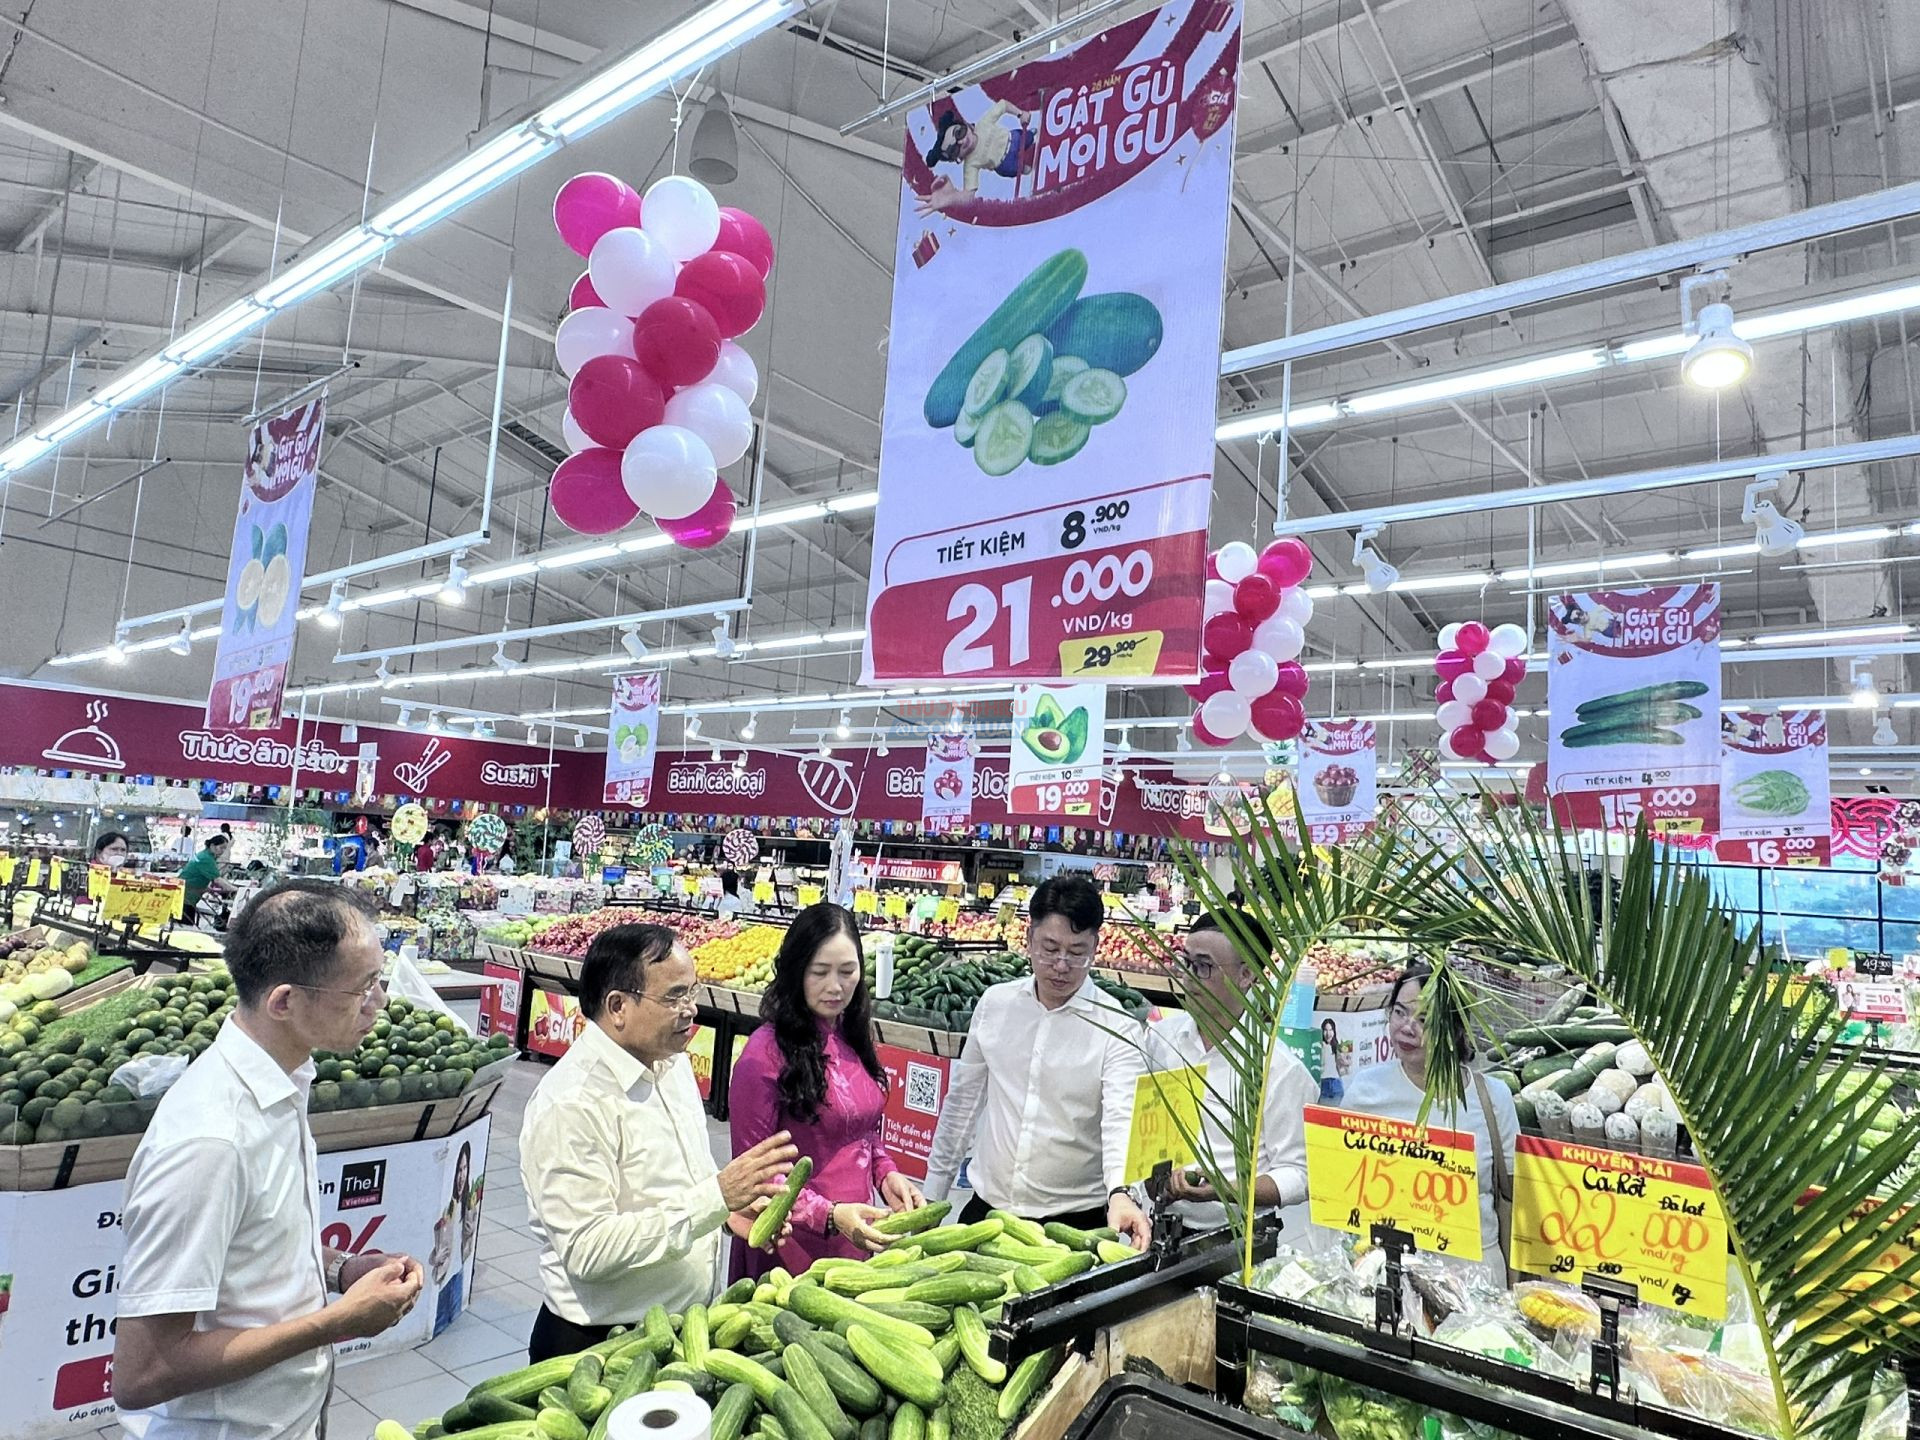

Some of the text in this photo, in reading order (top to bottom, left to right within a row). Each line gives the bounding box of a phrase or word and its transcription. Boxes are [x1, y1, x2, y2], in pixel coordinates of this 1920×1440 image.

[1045, 61, 1176, 137] GẬT GÙ
[1036, 124, 1108, 191] MỌI
[1113, 102, 1178, 164] GU
[1092, 524, 1121, 535] VND/kg
[937, 536, 975, 564] TIẾT
[980, 530, 1025, 556] KIỆM
[942, 574, 1034, 676] 21
[1062, 611, 1133, 635] VND/kg
[1625, 607, 1690, 629] GẬT GÙ
[1623, 625, 1693, 647] MỌI GU
[181, 732, 251, 764] Thức
[253, 739, 289, 767] ăn
[482, 761, 537, 787] Sushi
[668, 768, 765, 798] Bánh các loại
[1584, 777, 1604, 786] TIẾT
[1608, 776, 1632, 786] KIỆM
[1036, 784, 1062, 812] 19
[1599, 787, 1697, 829] 15 .000
[1311, 823, 1339, 845] 59
[1746, 840, 1781, 864] 16
[889, 865, 938, 879] BIRTHDAY
[1862, 958, 1877, 971] 49
[886, 1118, 902, 1132] Tích
[902, 1121, 921, 1138] điểm
[1340, 1114, 1399, 1137] KHUYẾN
[1562, 1145, 1673, 1179] KHUYẾN MÃI
[344, 1195, 378, 1208] Vietnam
[72, 1264, 121, 1299] Gi
[68, 1403, 117, 1423] (Áp dụng
